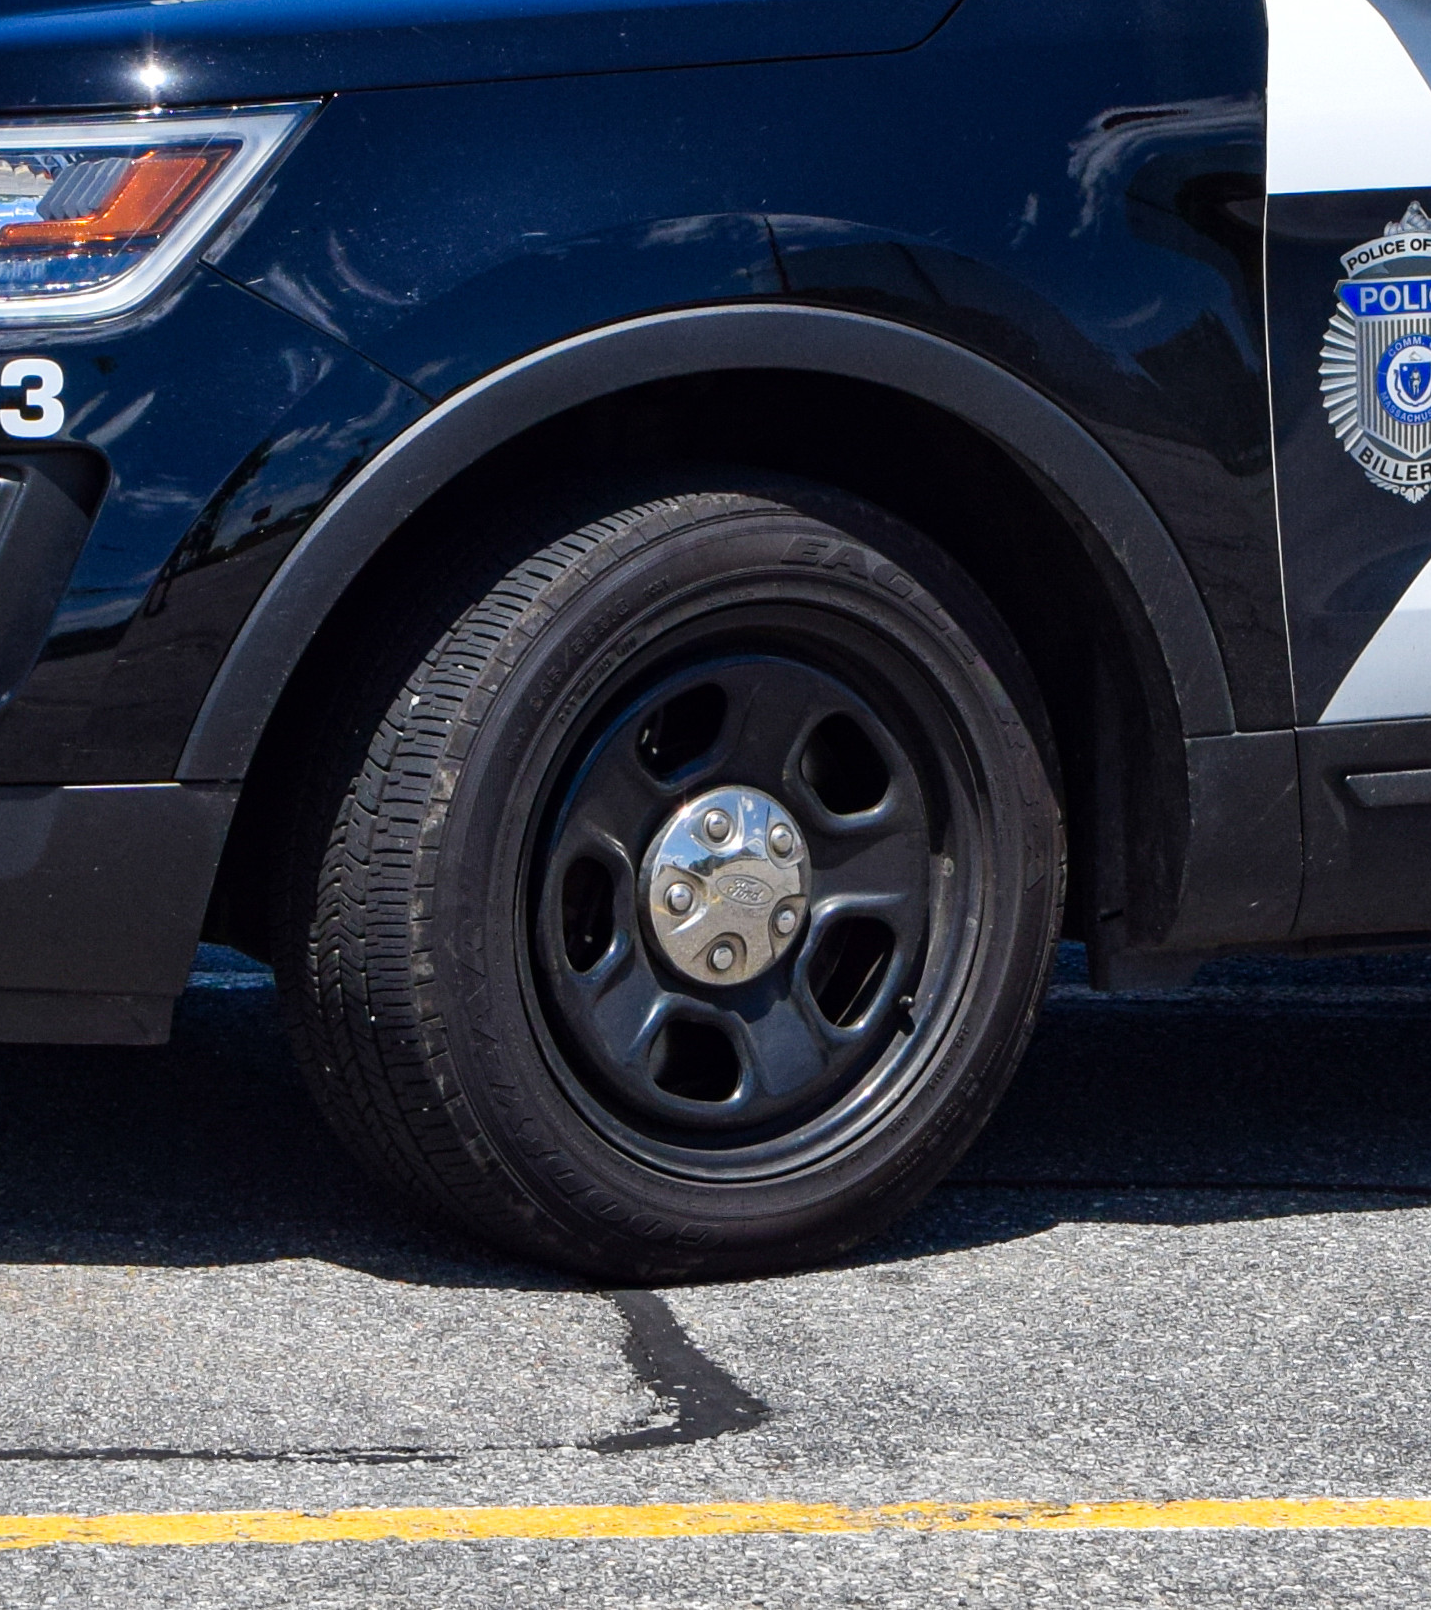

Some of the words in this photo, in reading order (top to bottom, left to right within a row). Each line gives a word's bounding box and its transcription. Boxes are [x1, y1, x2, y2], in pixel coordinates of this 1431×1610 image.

[1346, 240, 1407, 271] POLICE
[1388, 336, 1425, 359] COMM.
[781, 535, 979, 665] EAGLE
[728, 878, 765, 902] Ford
